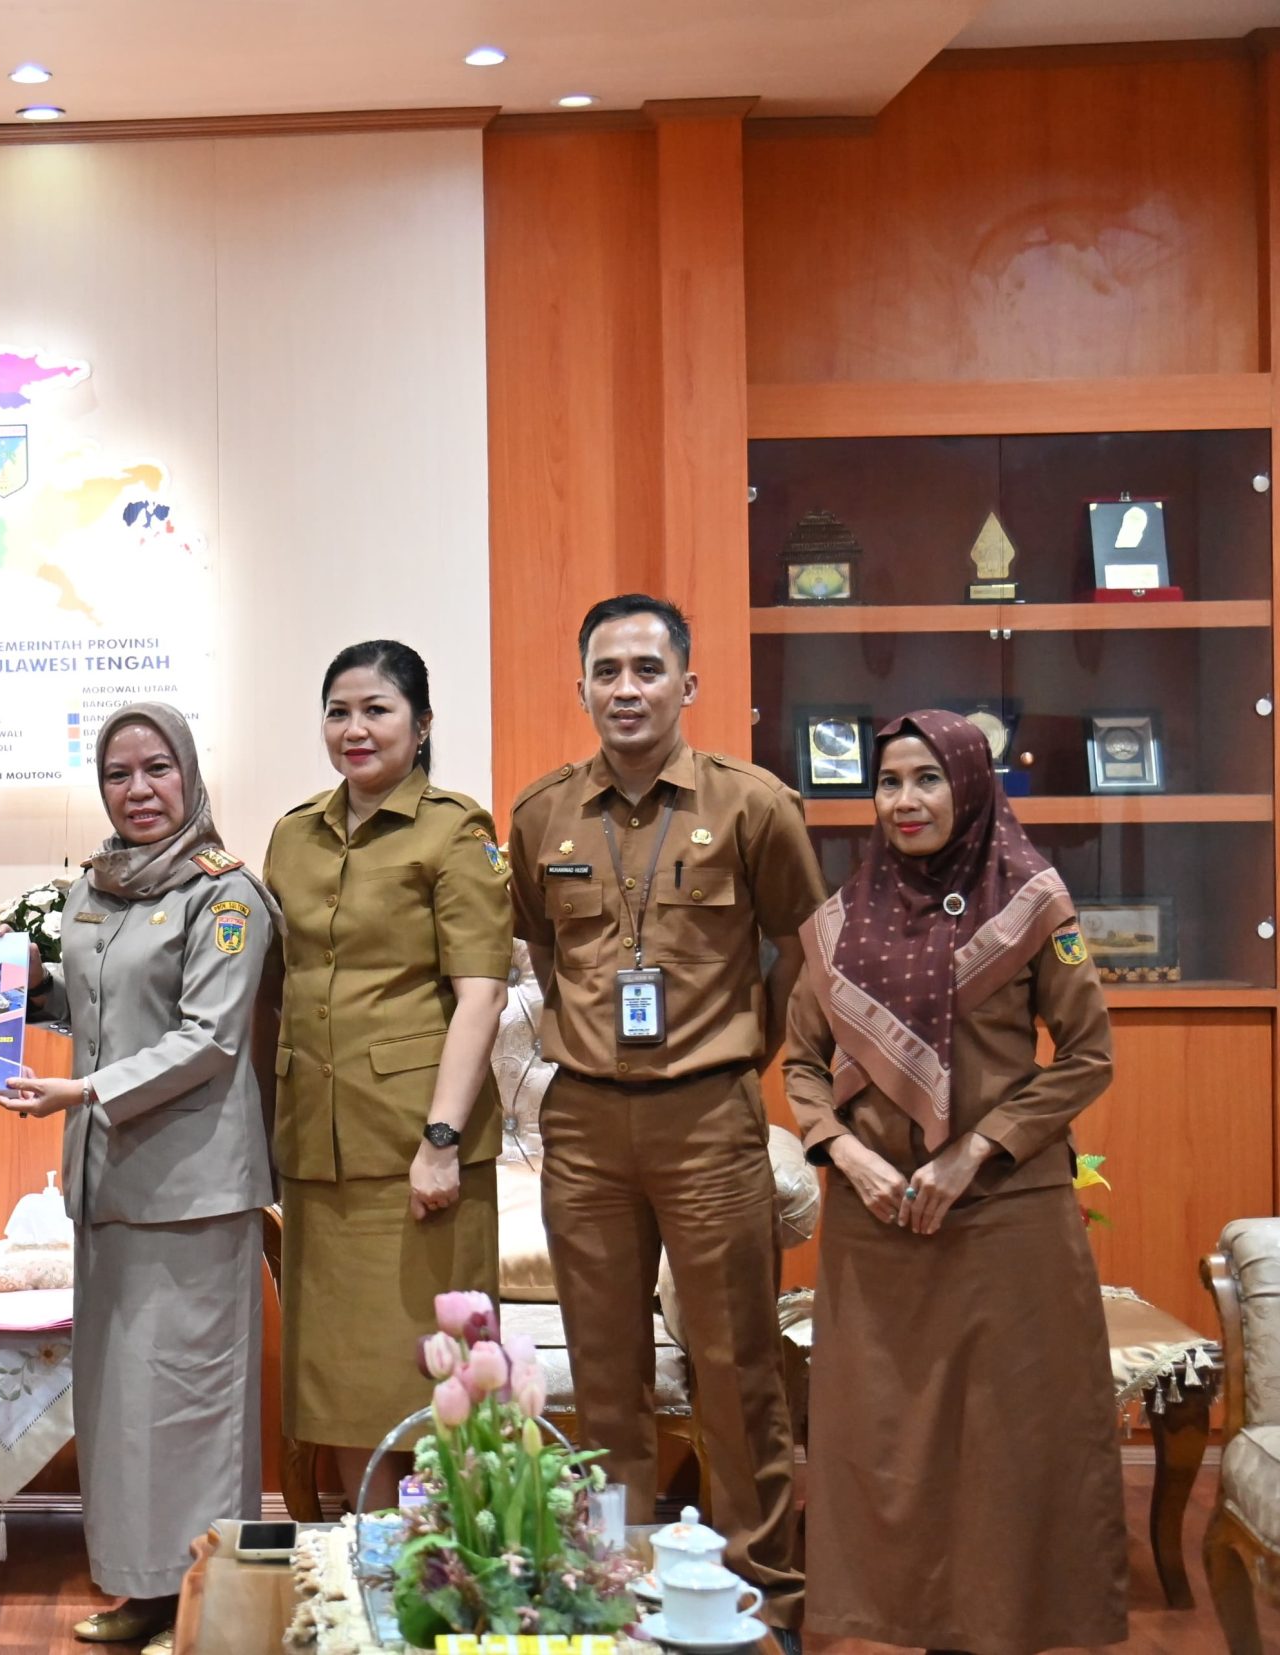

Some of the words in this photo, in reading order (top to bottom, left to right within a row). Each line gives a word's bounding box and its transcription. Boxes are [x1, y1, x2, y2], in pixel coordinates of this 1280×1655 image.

[88, 638, 159, 650] PROVINSI
[85, 655, 170, 671] TENGAH
[82, 686, 140, 694] MOROWALI
[144, 684, 178, 693] UTARA
[6, 771, 62, 780] MOUTONG
